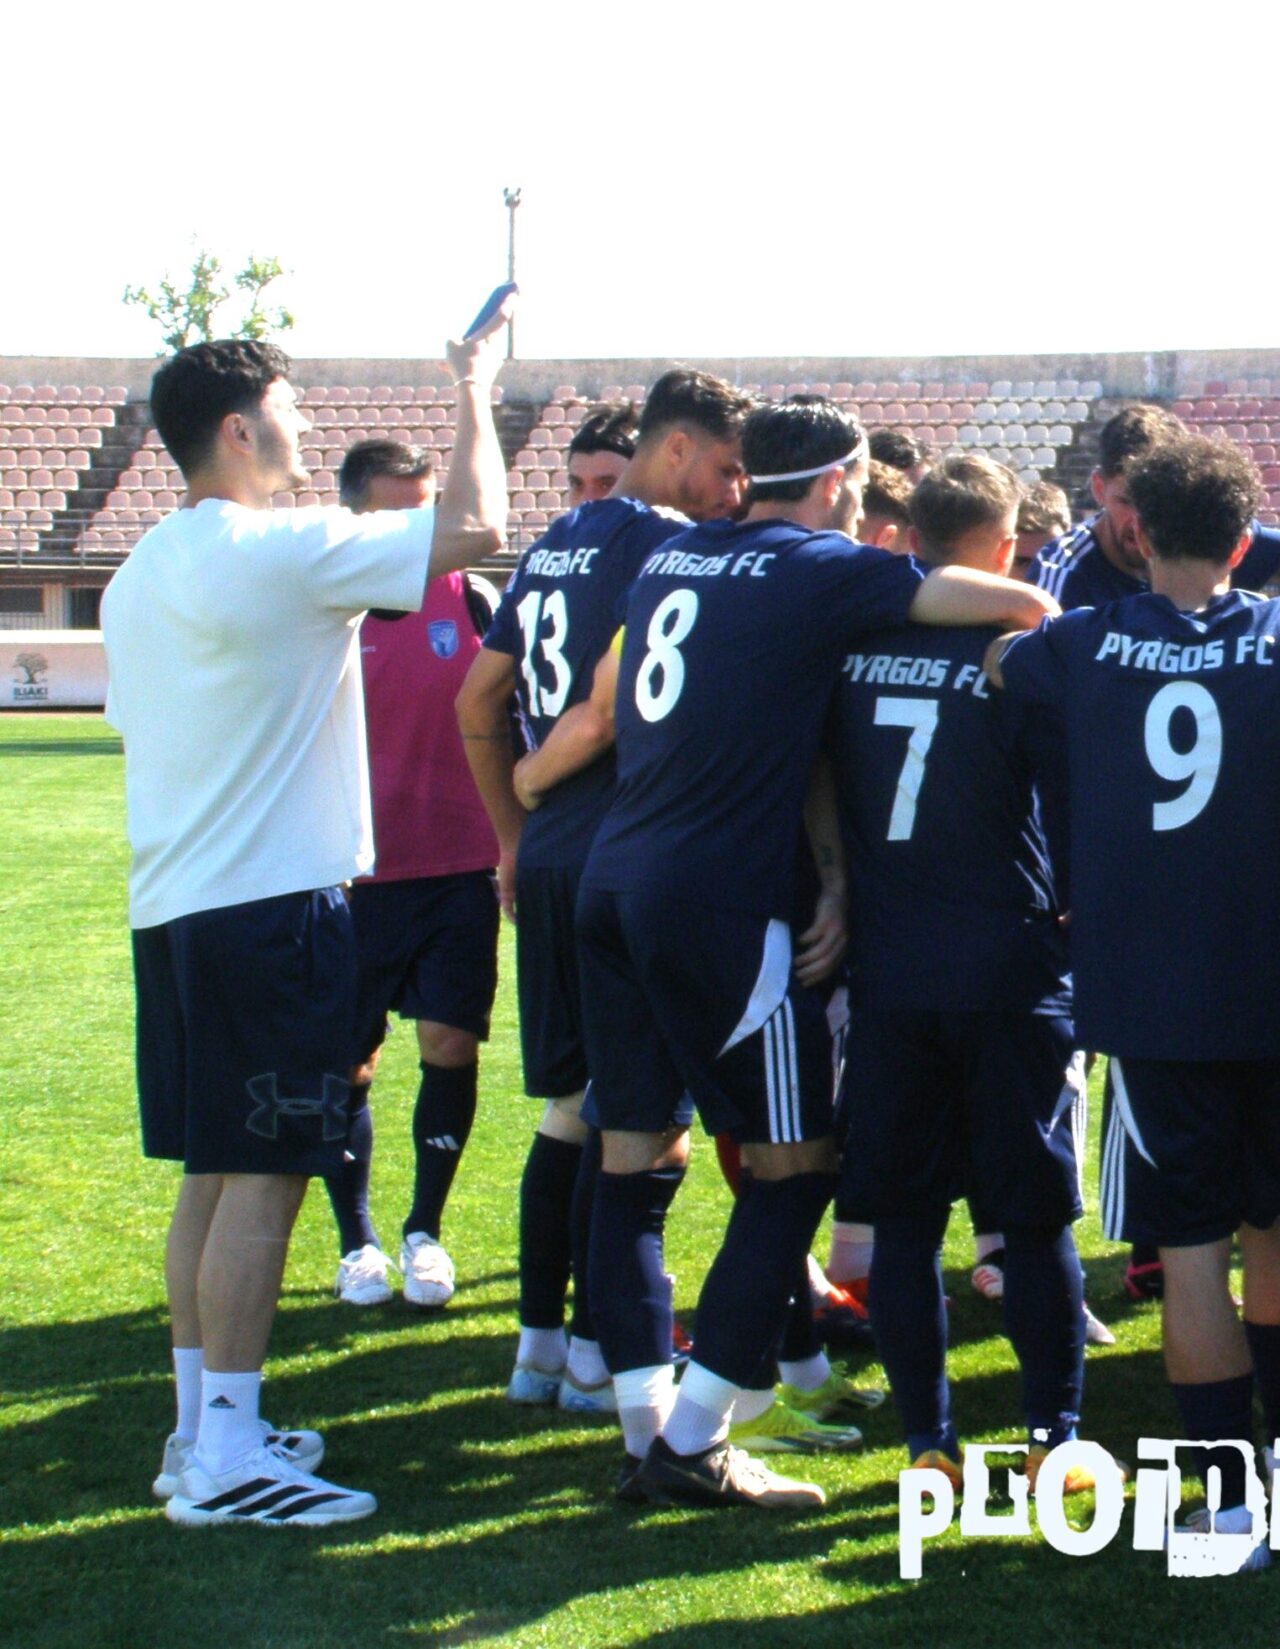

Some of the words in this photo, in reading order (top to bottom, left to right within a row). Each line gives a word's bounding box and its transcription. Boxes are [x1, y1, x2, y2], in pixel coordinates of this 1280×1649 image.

[568, 548, 599, 575] FC
[730, 552, 776, 576] FC
[517, 590, 573, 718] 13
[635, 588, 699, 723] 8
[1096, 632, 1225, 673] PYRGOS
[1235, 635, 1276, 665] FC
[873, 697, 938, 841] 7
[1144, 681, 1223, 832] 9
